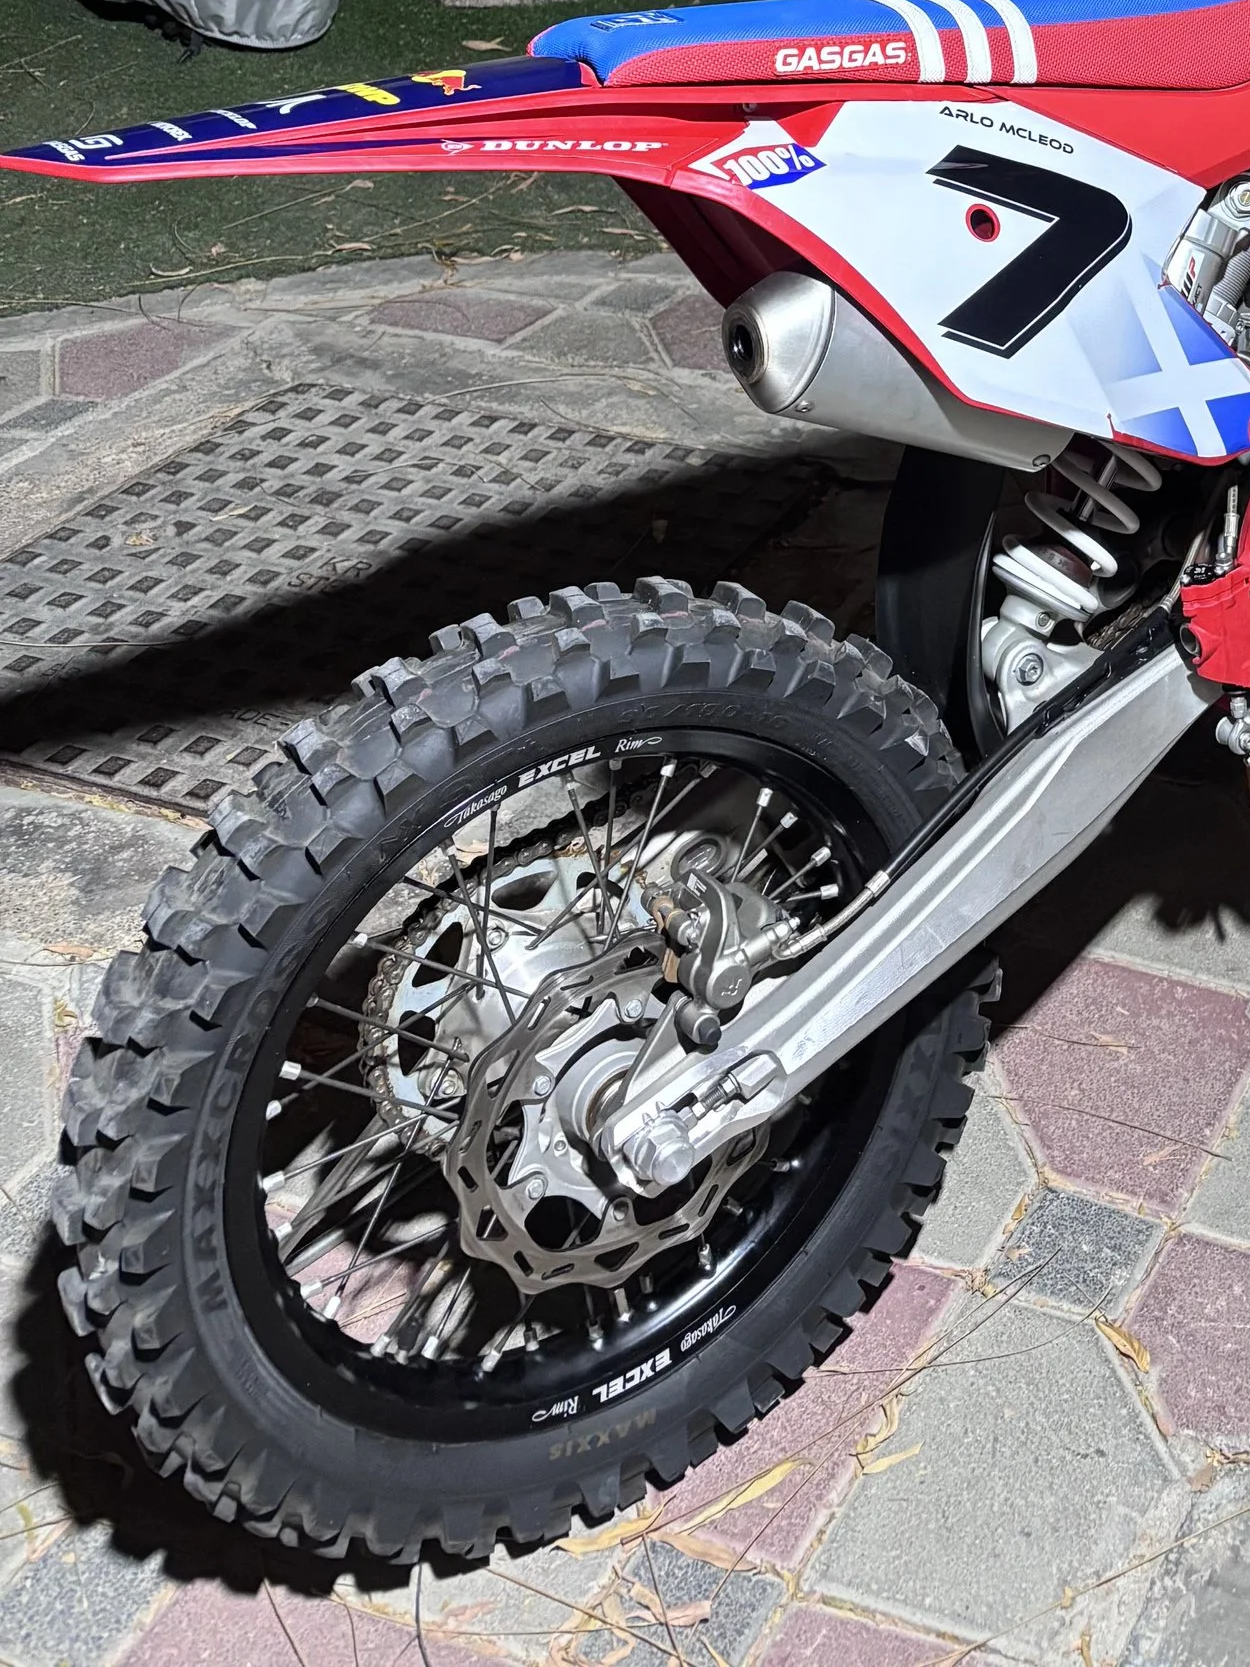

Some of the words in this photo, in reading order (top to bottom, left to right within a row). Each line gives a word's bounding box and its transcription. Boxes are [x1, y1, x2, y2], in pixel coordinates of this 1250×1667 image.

[774, 41, 907, 73] GASGAS
[479, 140, 665, 152] DUNLOP
[939, 105, 994, 128] ARLO
[999, 121, 1074, 155] MCLEOD
[723, 144, 816, 187] 100%
[926, 145, 1132, 360] 7
[444, 784, 507, 828] Takasago
[518, 745, 602, 788] EXCEL
[615, 736, 663, 753] Rim
[680, 1304, 736, 1352] Takasago
[592, 1347, 673, 1403] EXCEL
[531, 1395, 580, 1422] Rim
[549, 1408, 657, 1461] MAXXIS
